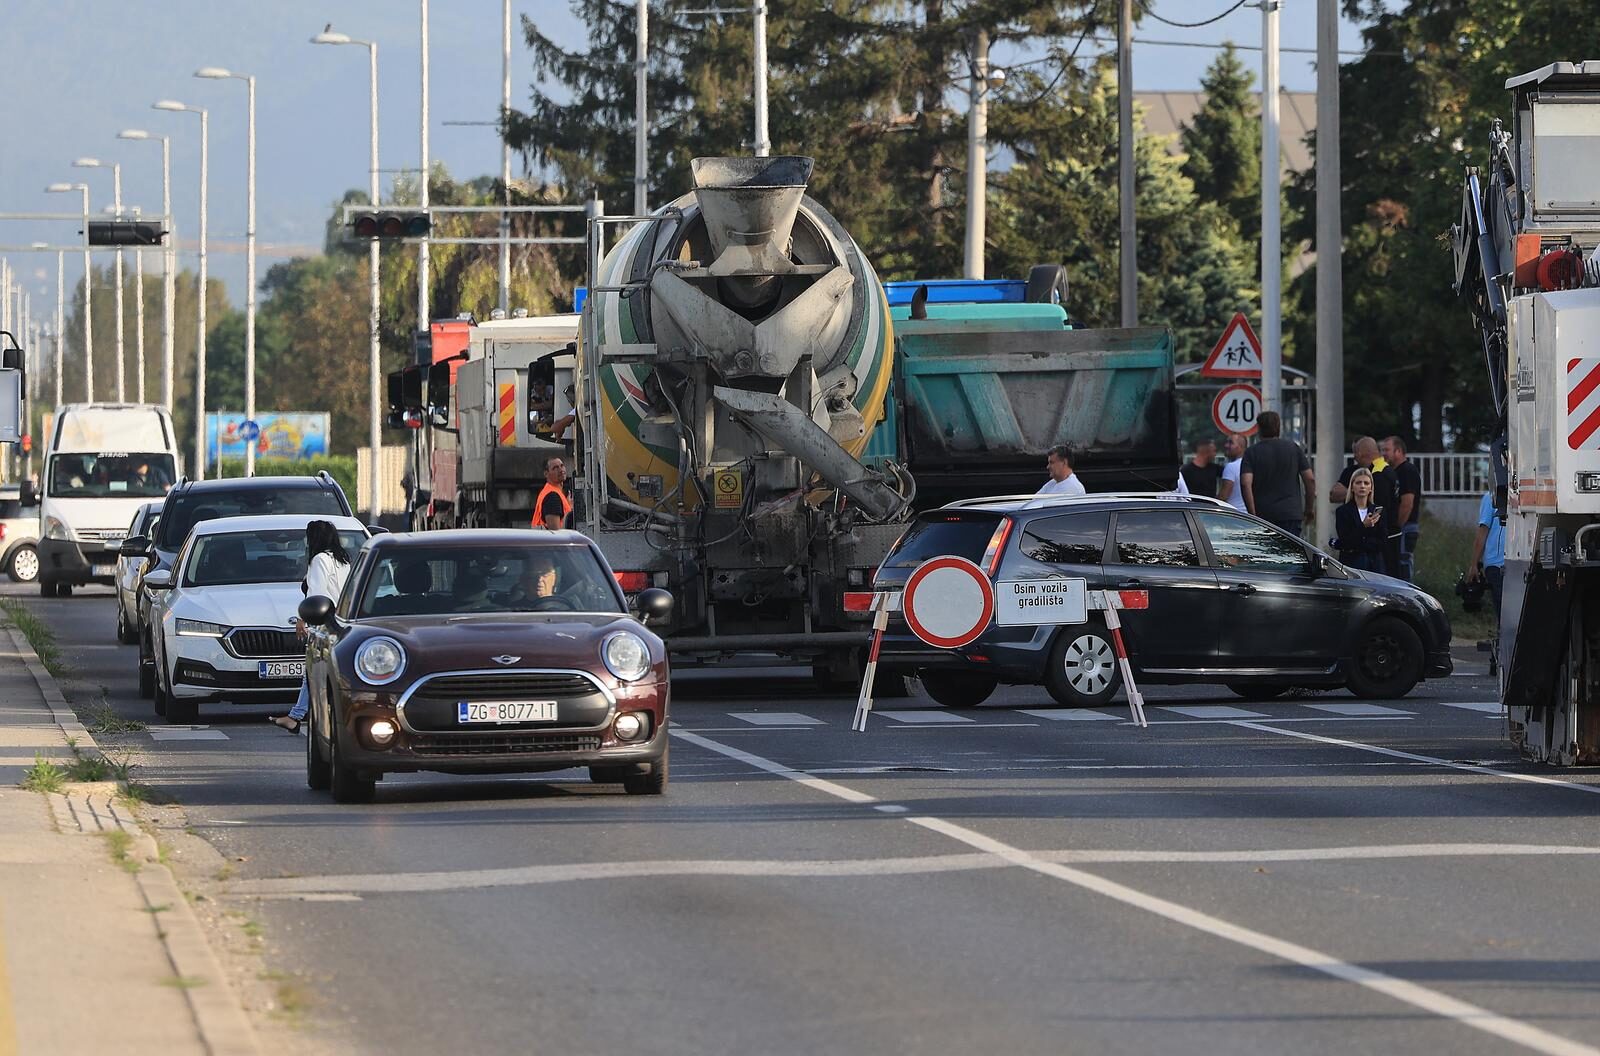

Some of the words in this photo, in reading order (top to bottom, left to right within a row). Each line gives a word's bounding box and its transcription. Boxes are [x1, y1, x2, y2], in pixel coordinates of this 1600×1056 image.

[1226, 399, 1254, 422] 40
[1014, 583, 1036, 594] Osim
[1041, 582, 1068, 593] vozila
[1018, 595, 1063, 608] gradilišta
[268, 663, 281, 676] ZG
[470, 705, 488, 720] ZG
